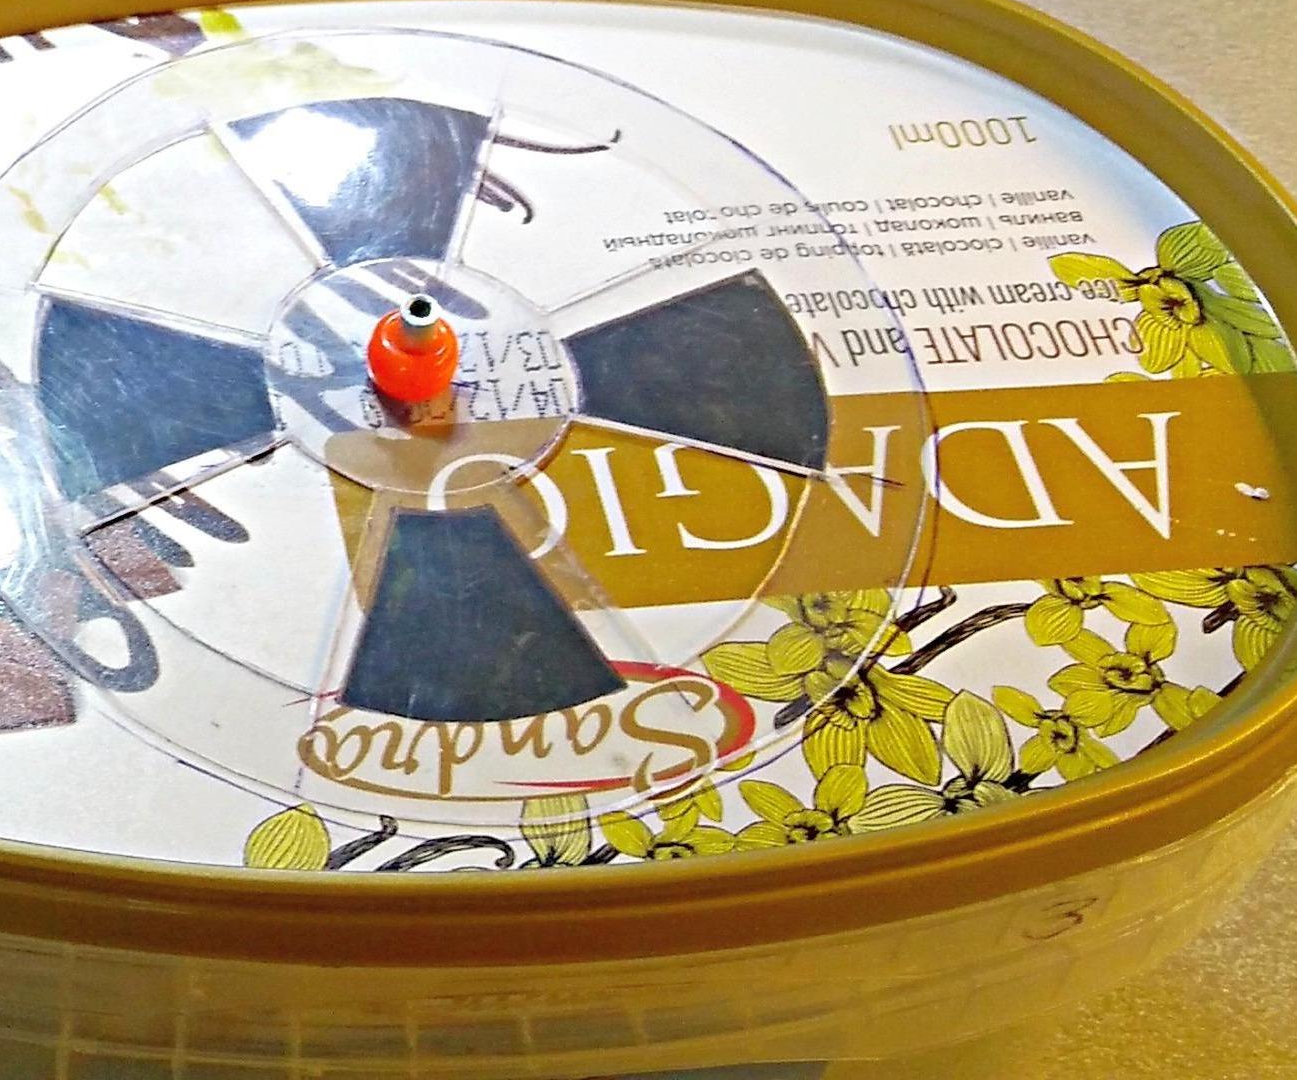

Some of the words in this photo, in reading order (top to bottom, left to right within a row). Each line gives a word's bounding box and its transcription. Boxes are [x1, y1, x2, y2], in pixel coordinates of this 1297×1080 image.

[887, 115, 1037, 151] 1000ml
[885, 193, 983, 212] chocolat
[1001, 189, 1074, 206] vanille
[768, 202, 799, 217] de
[999, 210, 1084, 228] ваниль
[873, 215, 982, 234] шоколад
[759, 247, 790, 262] de
[795, 242, 884, 260] topping
[900, 237, 1003, 258] ciocolată
[922, 284, 984, 316] with
[988, 280, 1072, 307] cream
[1077, 278, 1121, 304] ice
[784, 287, 917, 319] chocolate
[840, 327, 907, 367] and
[912, 317, 1144, 365] CHOCOLATE
[298, 681, 717, 801] Sandra
